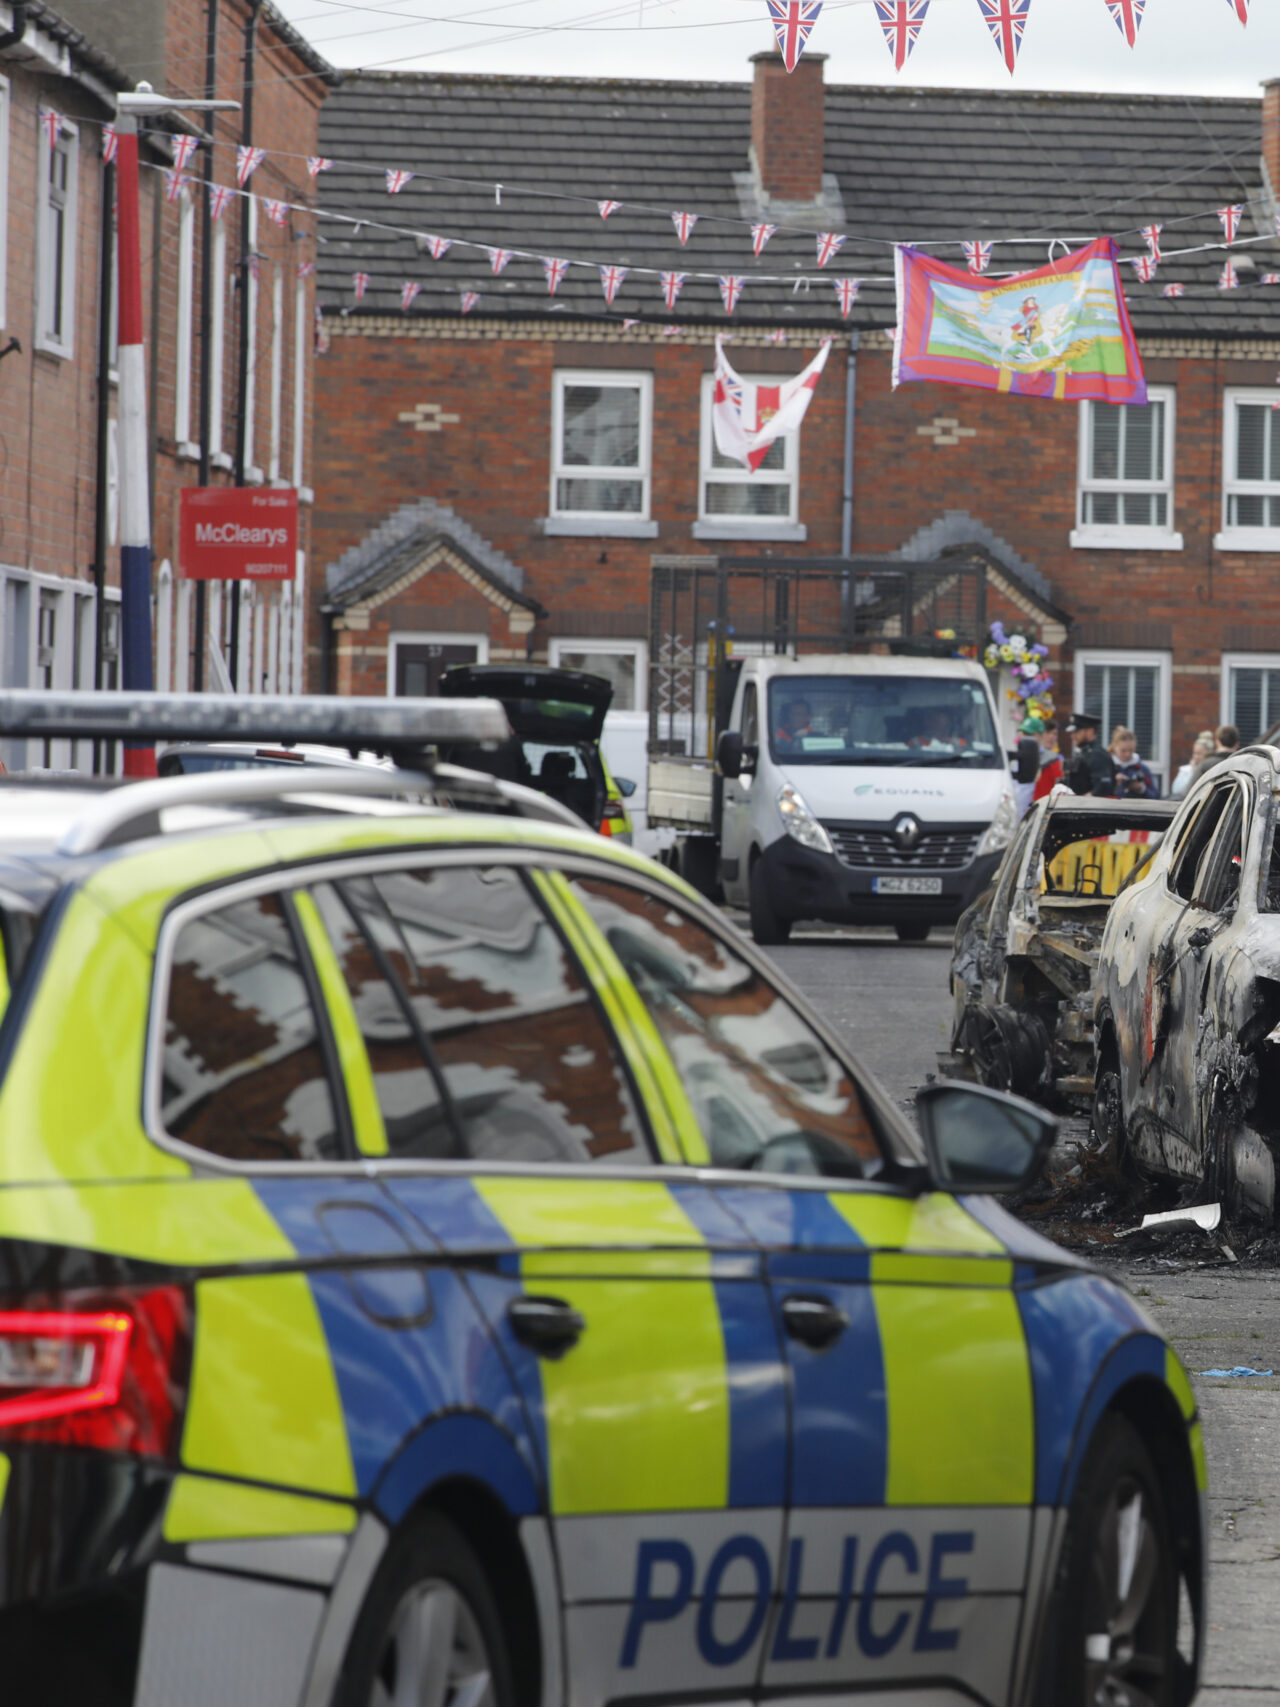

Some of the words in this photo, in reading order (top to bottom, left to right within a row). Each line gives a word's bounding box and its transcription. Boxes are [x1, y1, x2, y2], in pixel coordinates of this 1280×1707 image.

[195, 523, 287, 547] McClearys
[874, 788, 944, 796] EQUANS
[617, 1530, 975, 1669] POLICE
